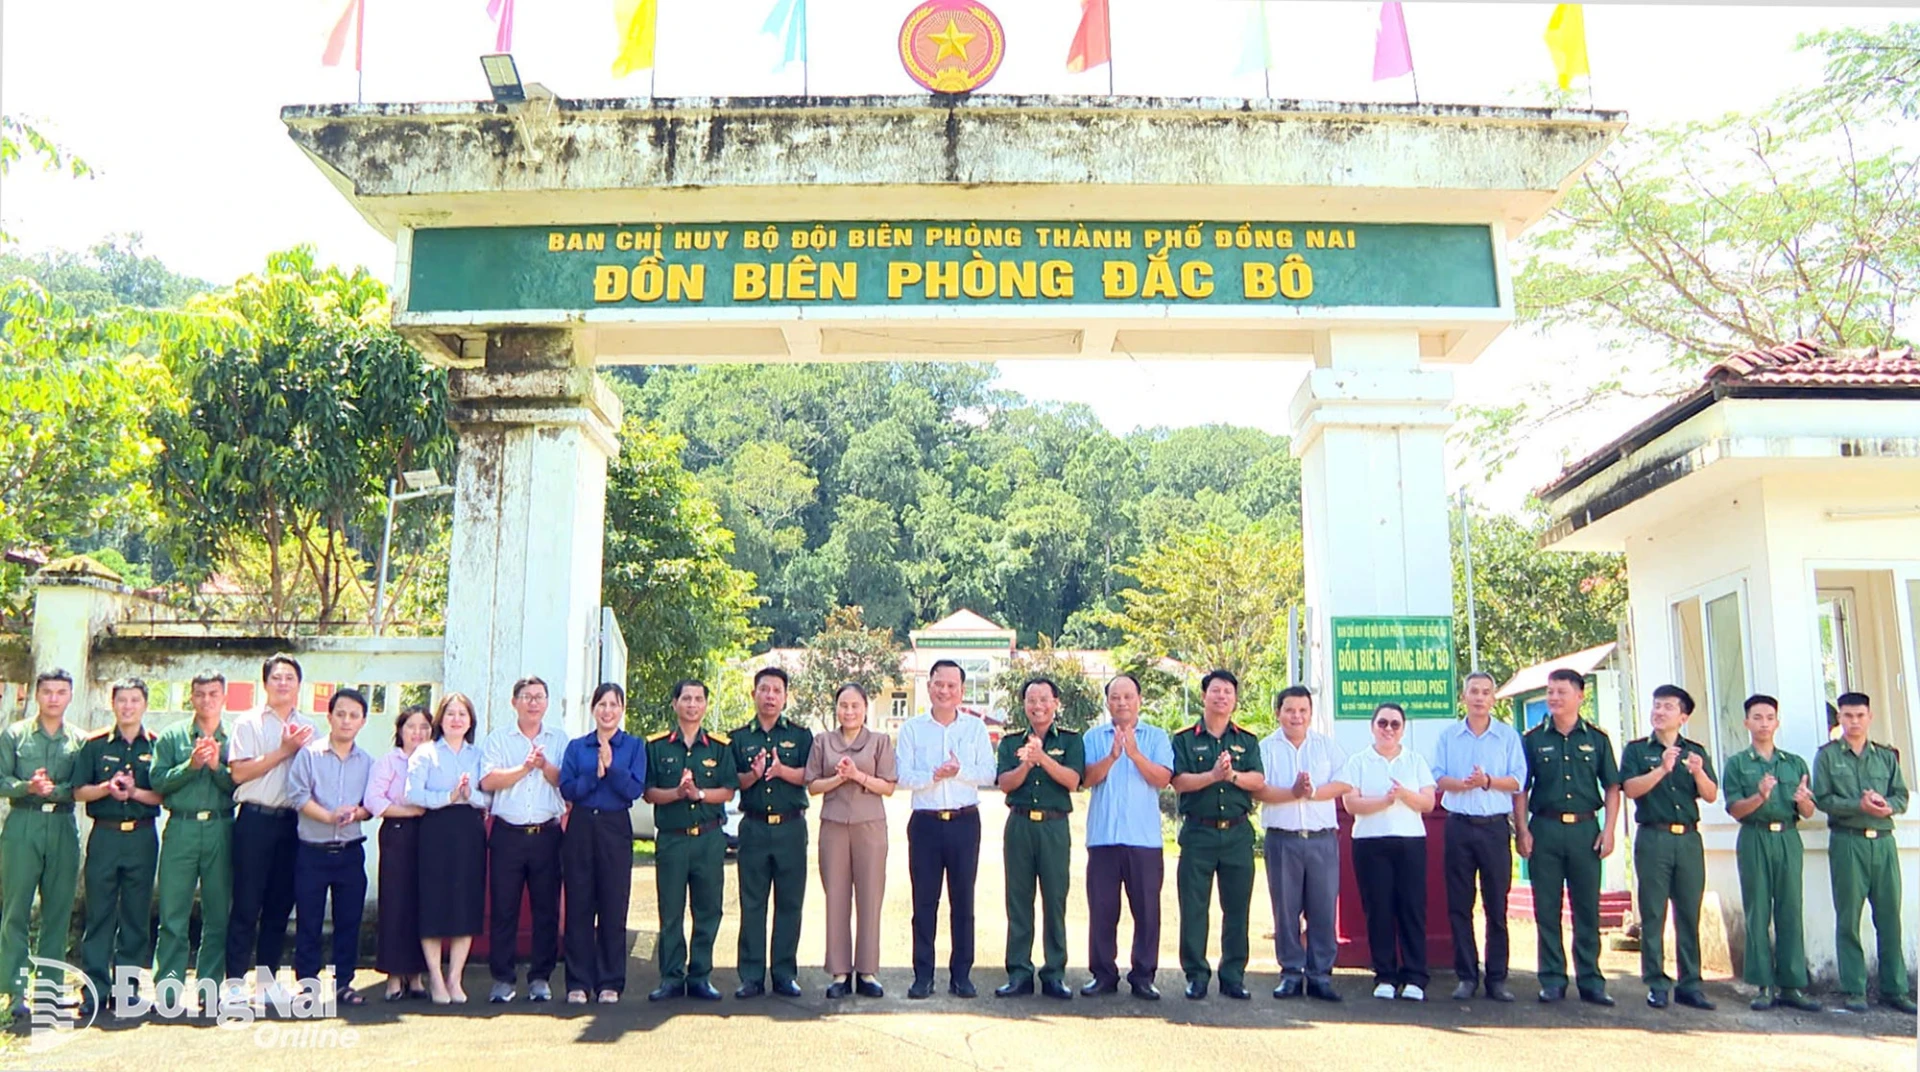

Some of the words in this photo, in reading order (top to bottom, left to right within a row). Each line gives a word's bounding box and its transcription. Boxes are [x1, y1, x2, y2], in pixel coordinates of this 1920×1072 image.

[548, 232, 605, 251] BAN
[674, 230, 729, 249] HUY
[743, 225, 780, 252] BỘ
[791, 224, 837, 252] ĐỘI
[849, 222, 912, 247] BIÊN
[925, 222, 1022, 247] PHÒNG
[1035, 223, 1131, 248] THÀNH
[1144, 222, 1203, 248] PHỐ
[1215, 222, 1294, 248] ĐỒNG
[1305, 230, 1356, 248] NAI
[593, 250, 705, 301] ĐỒN
[733, 254, 857, 300] BIÊN
[888, 250, 1074, 299] PHÒNG
[1102, 247, 1214, 299] ĐẮC
[1243, 253, 1314, 299] BÔ
[1429, 680, 1448, 695] POST
